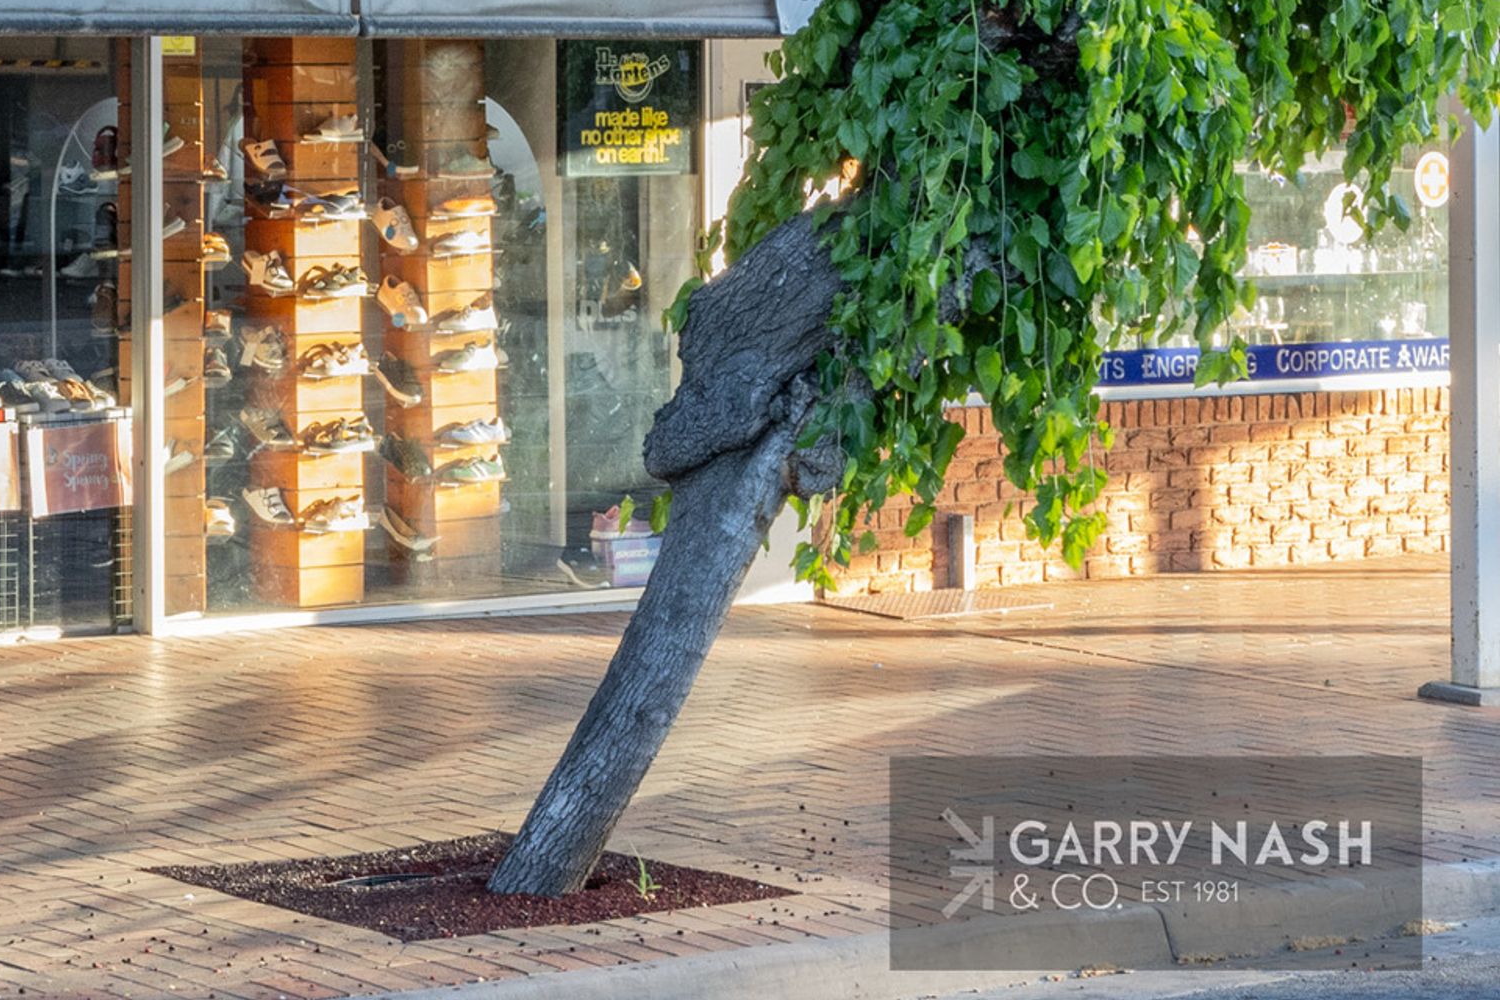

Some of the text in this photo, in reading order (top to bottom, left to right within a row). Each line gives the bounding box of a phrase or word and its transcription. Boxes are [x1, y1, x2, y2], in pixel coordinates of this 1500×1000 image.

[595, 106, 668, 127] made like
[581, 129, 602, 145] no
[603, 127, 643, 145] other
[596, 147, 617, 164] on
[1142, 353, 1257, 378] ENGRG
[1276, 346, 1390, 373] CORPORATE
[1397, 343, 1450, 369] AWAR
